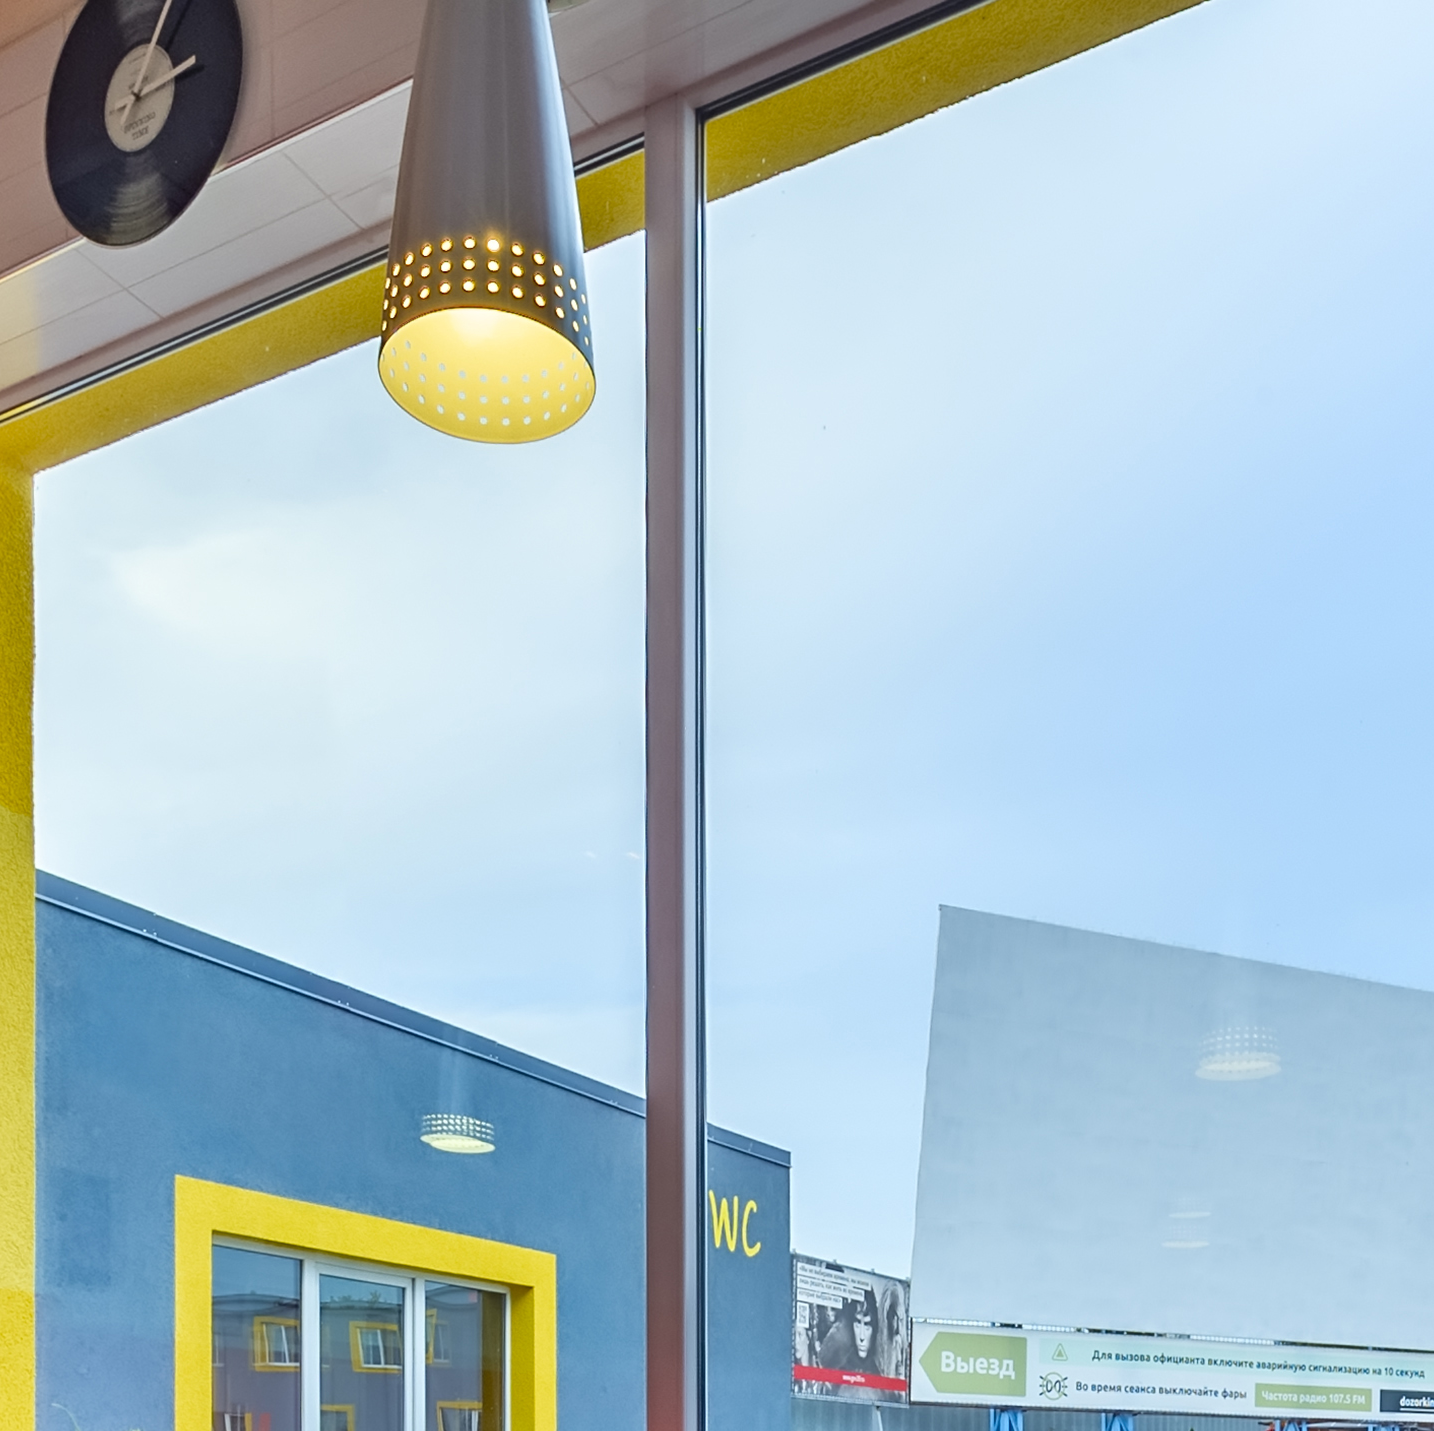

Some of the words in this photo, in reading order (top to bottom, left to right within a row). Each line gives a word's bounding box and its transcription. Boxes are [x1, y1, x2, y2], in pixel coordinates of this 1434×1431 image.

[708, 1189, 761, 1257] WC
[941, 1350, 1016, 1380] Выезд
[1092, 1350, 1113, 1362] Для
[1115, 1352, 1151, 1363] вызова
[1153, 1353, 1205, 1366] официанта
[1208, 1357, 1254, 1369] включите
[1256, 1360, 1307, 1373] аварийную
[1309, 1364, 1370, 1376] сигнализацию
[1372, 1368, 1382, 1376] на
[1384, 1367, 1394, 1377] 10
[1395, 1369, 1425, 1379] секунд
[1076, 1381, 1089, 1392] Во
[1091, 1383, 1122, 1394] время
[1124, 1385, 1156, 1395] сеанса
[1159, 1386, 1219, 1398] выключайте
[1221, 1387, 1247, 1400] фары
[1261, 1391, 1298, 1402] Частота
[1299, 1391, 1327, 1404] радио
[1329, 1393, 1351, 1404] 107.5
[1352, 1394, 1366, 1405] FM
